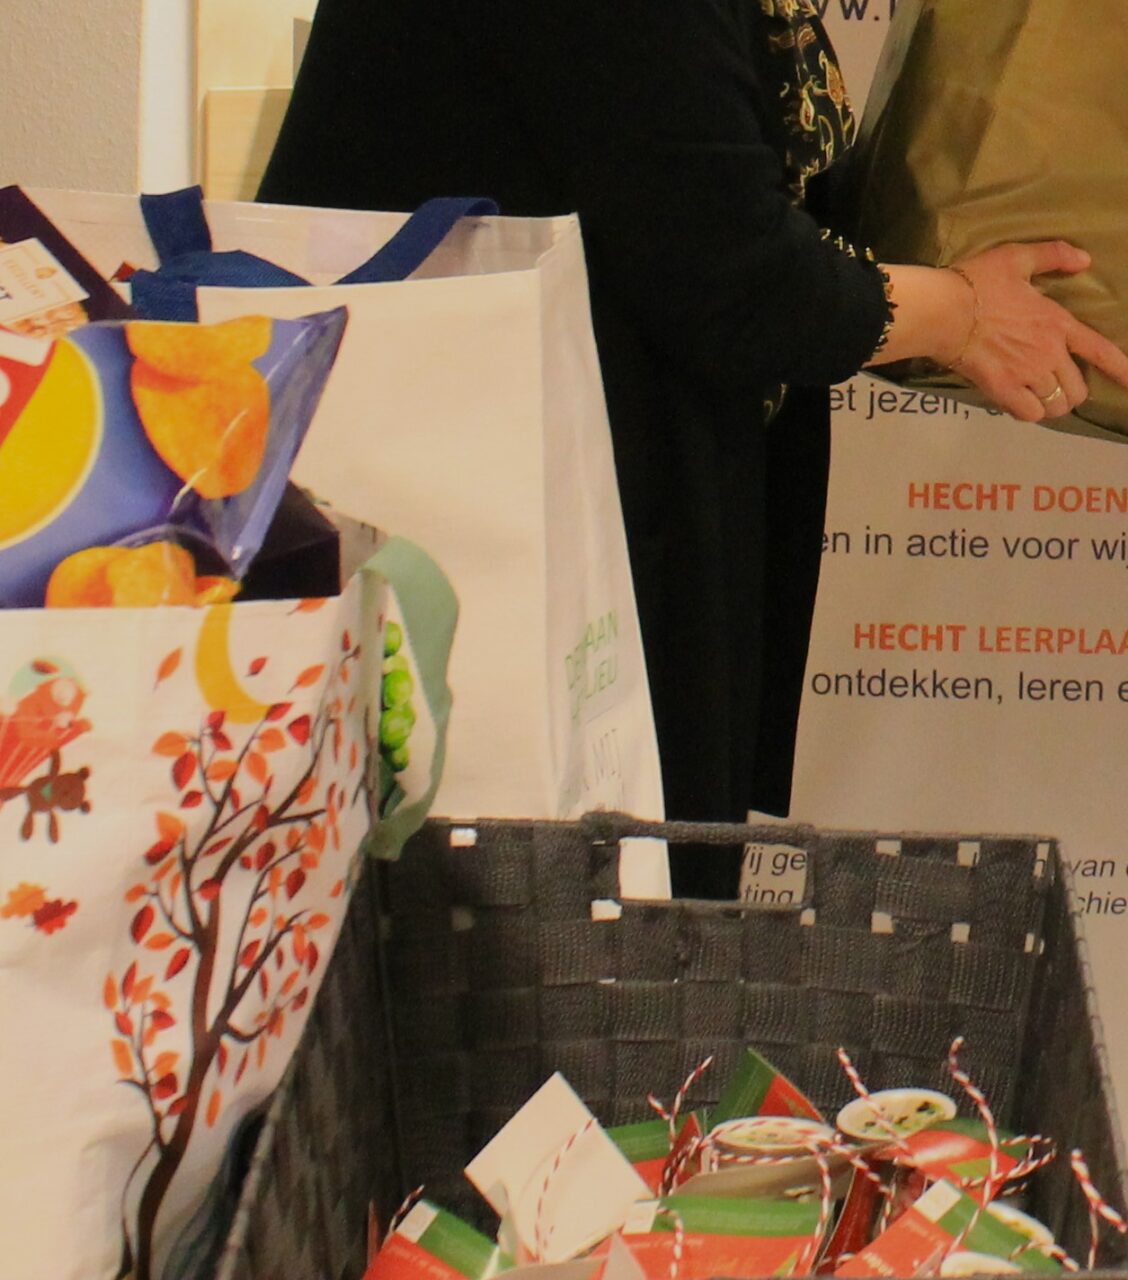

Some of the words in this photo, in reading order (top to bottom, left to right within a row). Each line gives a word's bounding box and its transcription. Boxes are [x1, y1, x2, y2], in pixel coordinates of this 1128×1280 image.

[908, 482, 1021, 511] HECHT
[1033, 486, 1128, 513] DOEN
[865, 525, 893, 555] in
[906, 528, 989, 558] actie
[1002, 536, 1080, 560] voor
[854, 623, 966, 652] HECHT
[811, 669, 1002, 705] ontdekken,
[1018, 672, 1103, 702] leren
